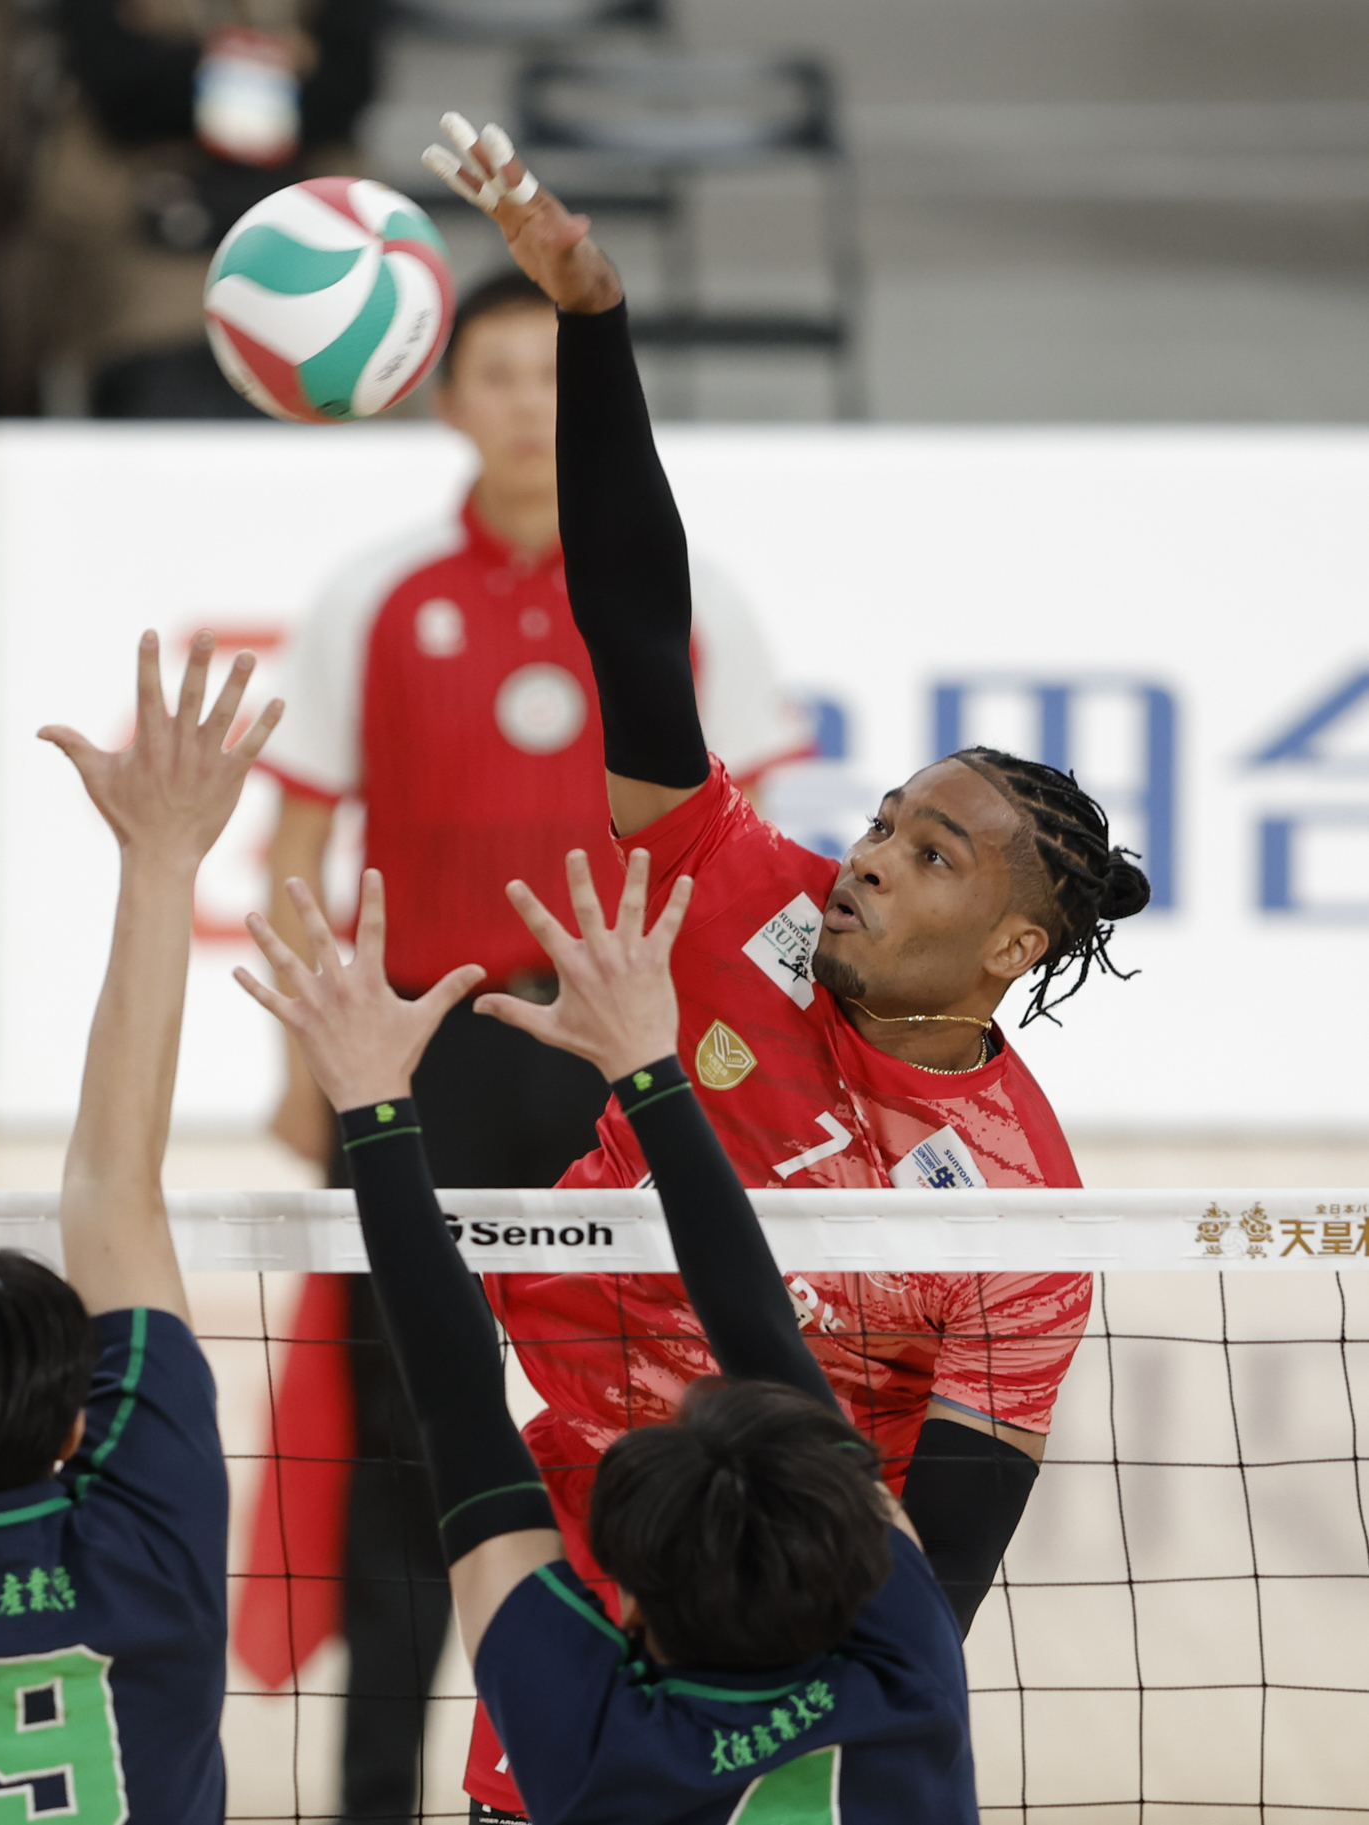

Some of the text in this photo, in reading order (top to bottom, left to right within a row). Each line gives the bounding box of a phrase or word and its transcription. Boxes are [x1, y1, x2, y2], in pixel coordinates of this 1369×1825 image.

[765, 921, 799, 955] SUI
[779, 912, 811, 947] SUNTORY
[772, 1110, 854, 1180] 7
[469, 1222, 613, 1246] Senoh
